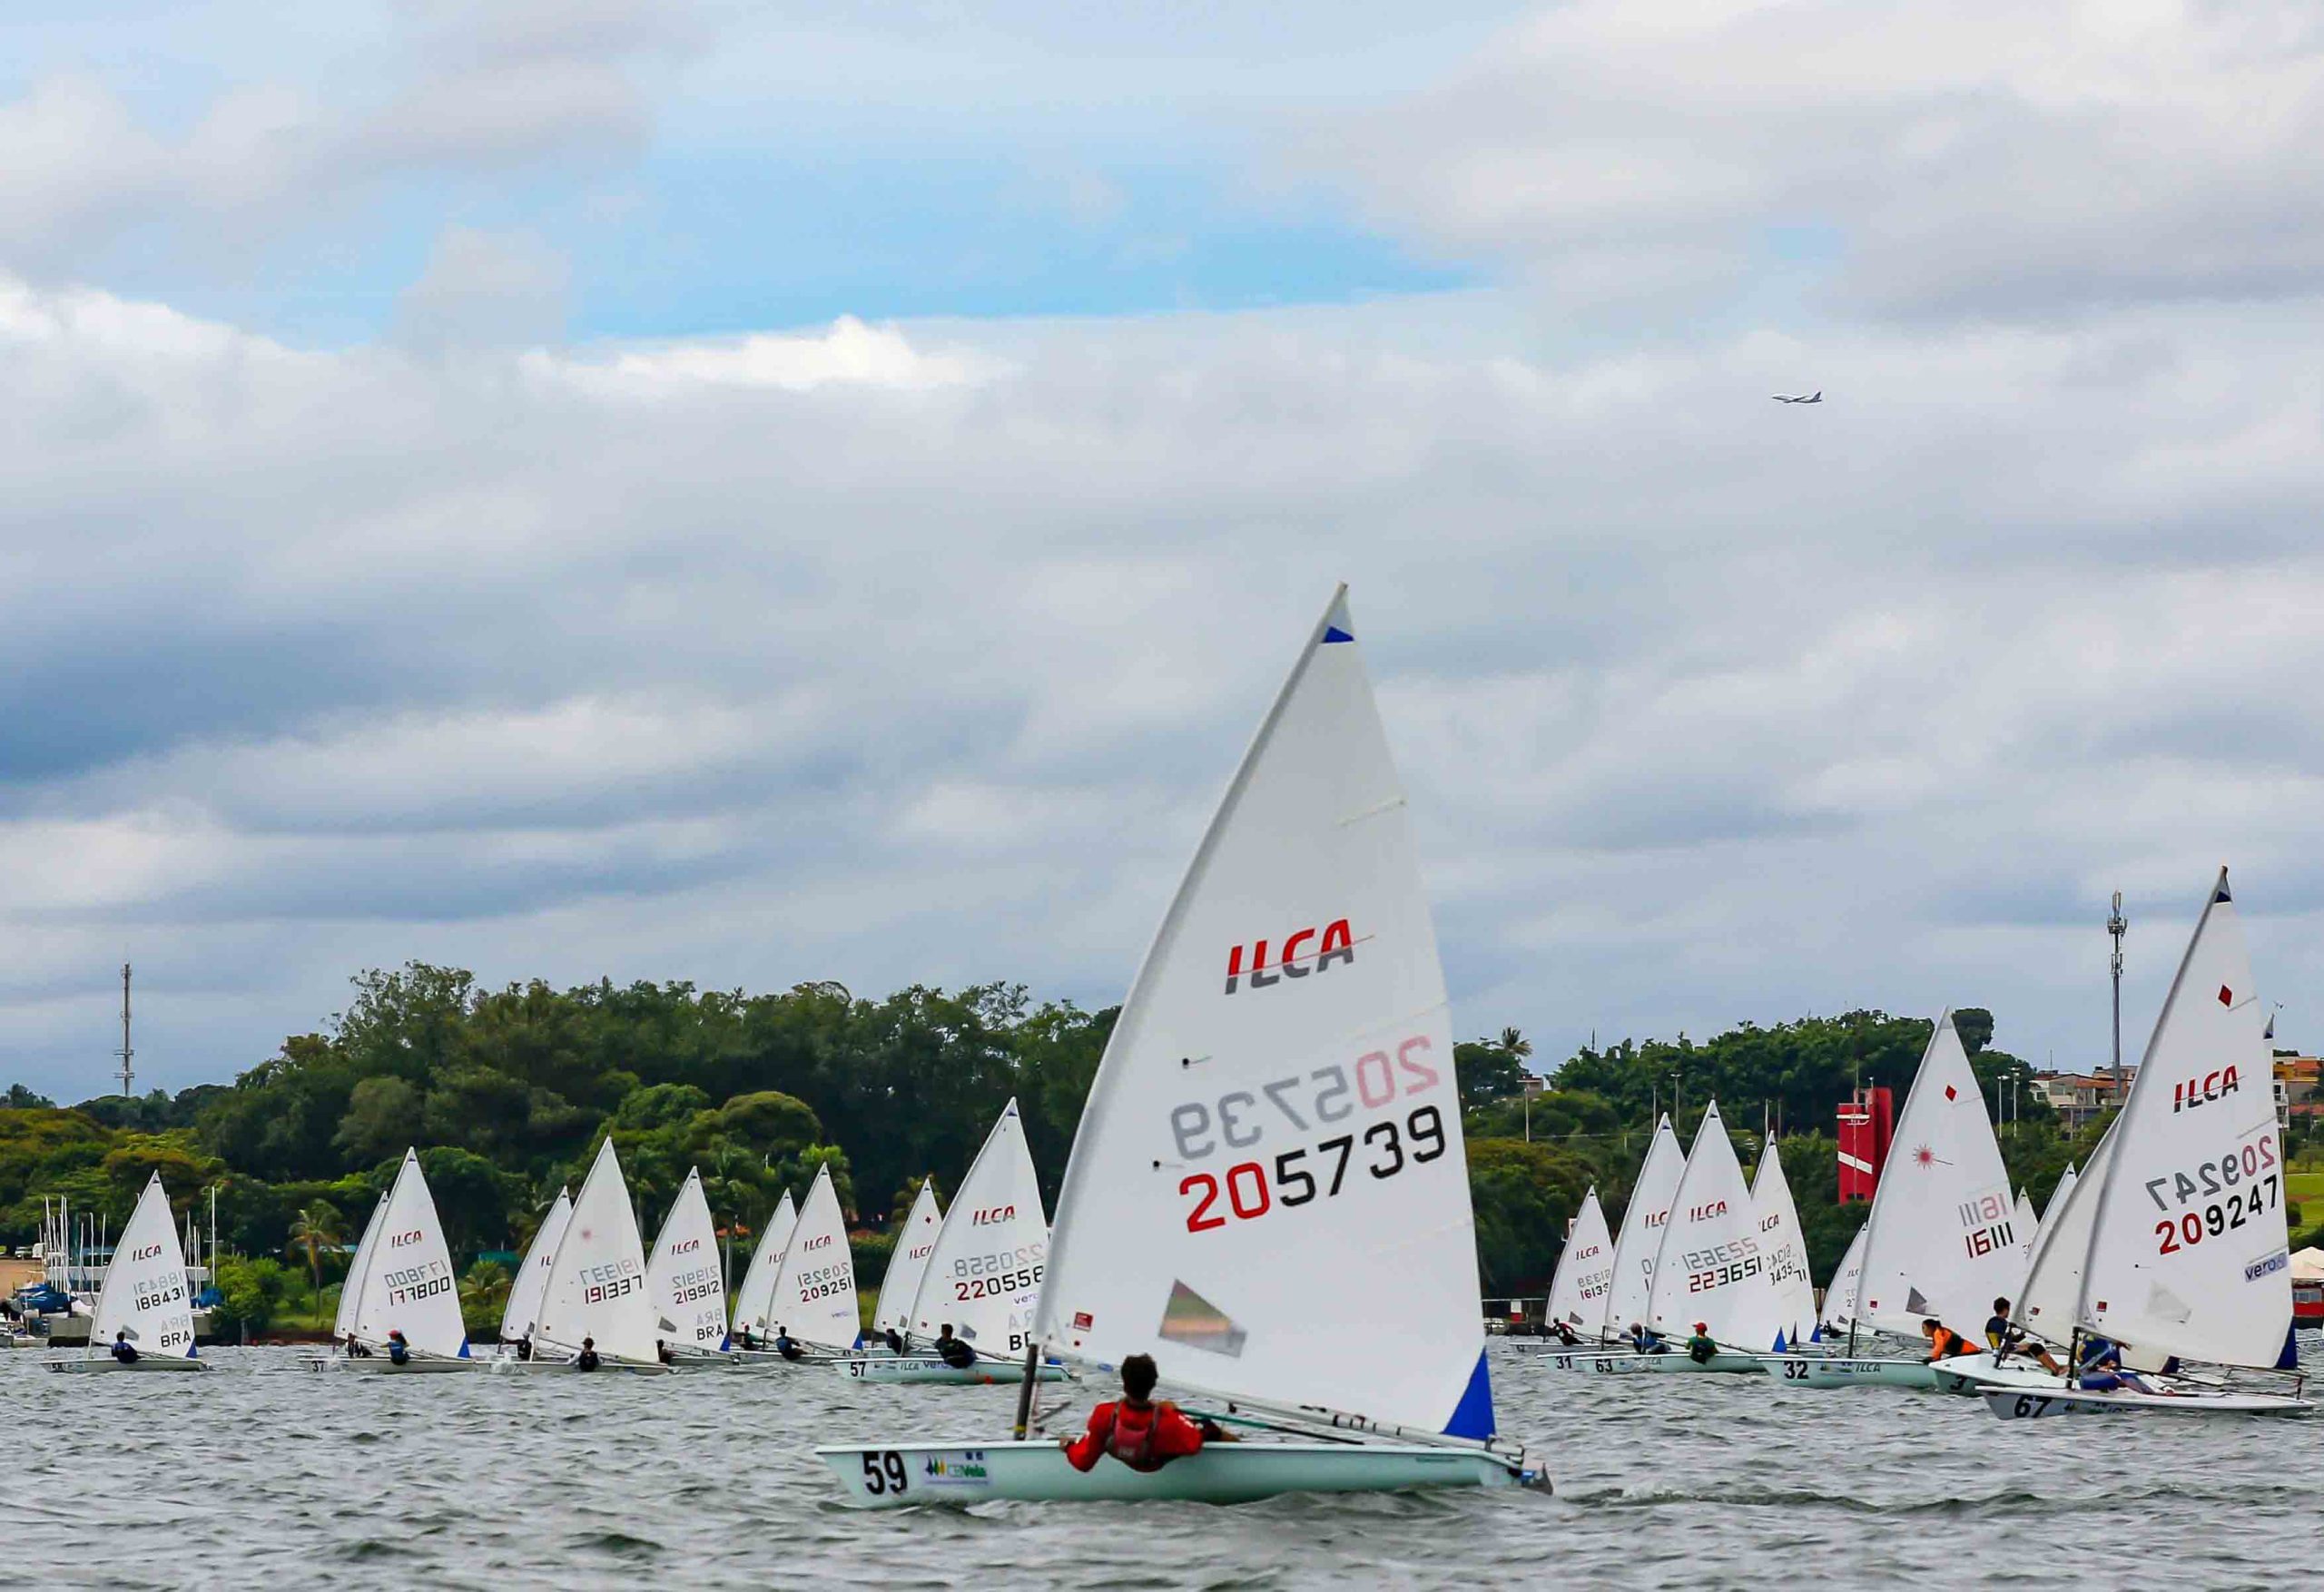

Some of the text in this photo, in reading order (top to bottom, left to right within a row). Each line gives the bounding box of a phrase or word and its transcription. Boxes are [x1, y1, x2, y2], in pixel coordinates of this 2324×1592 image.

[1224, 918, 1354, 996] ILCA
[2173, 1065, 2239, 1114] ILCA
[1179, 1105, 1446, 1233] 205739
[972, 1204, 1016, 1226] ILCA
[1689, 1200, 1728, 1223] ILCA
[2154, 1173, 2279, 1256] 209247
[391, 1229, 422, 1249] ILCA
[671, 1239, 700, 1256] ILCA
[803, 1234, 832, 1253] ILCA
[1965, 1221, 2014, 1259] 16111
[133, 1244, 162, 1262] ILCA
[1575, 1245, 1600, 1261] ILCA
[1689, 1255, 1763, 1293] 223651
[135, 1285, 185, 1312] 188431
[389, 1275, 451, 1307] 177800
[584, 1274, 644, 1305] 191337
[673, 1280, 720, 1305] 219912
[800, 1275, 852, 1303] 209251
[160, 1330, 192, 1348] BRA
[696, 1323, 724, 1341] BRA
[311, 1361, 325, 1372] 37
[851, 1361, 867, 1378] 57
[1555, 1355, 1572, 1370] 31
[1595, 1359, 1613, 1373] 63
[1783, 1361, 1809, 1381] 32
[1856, 1361, 1881, 1372] ILCA
[2014, 1394, 2053, 1419] 67
[862, 1450, 908, 1496] 59
